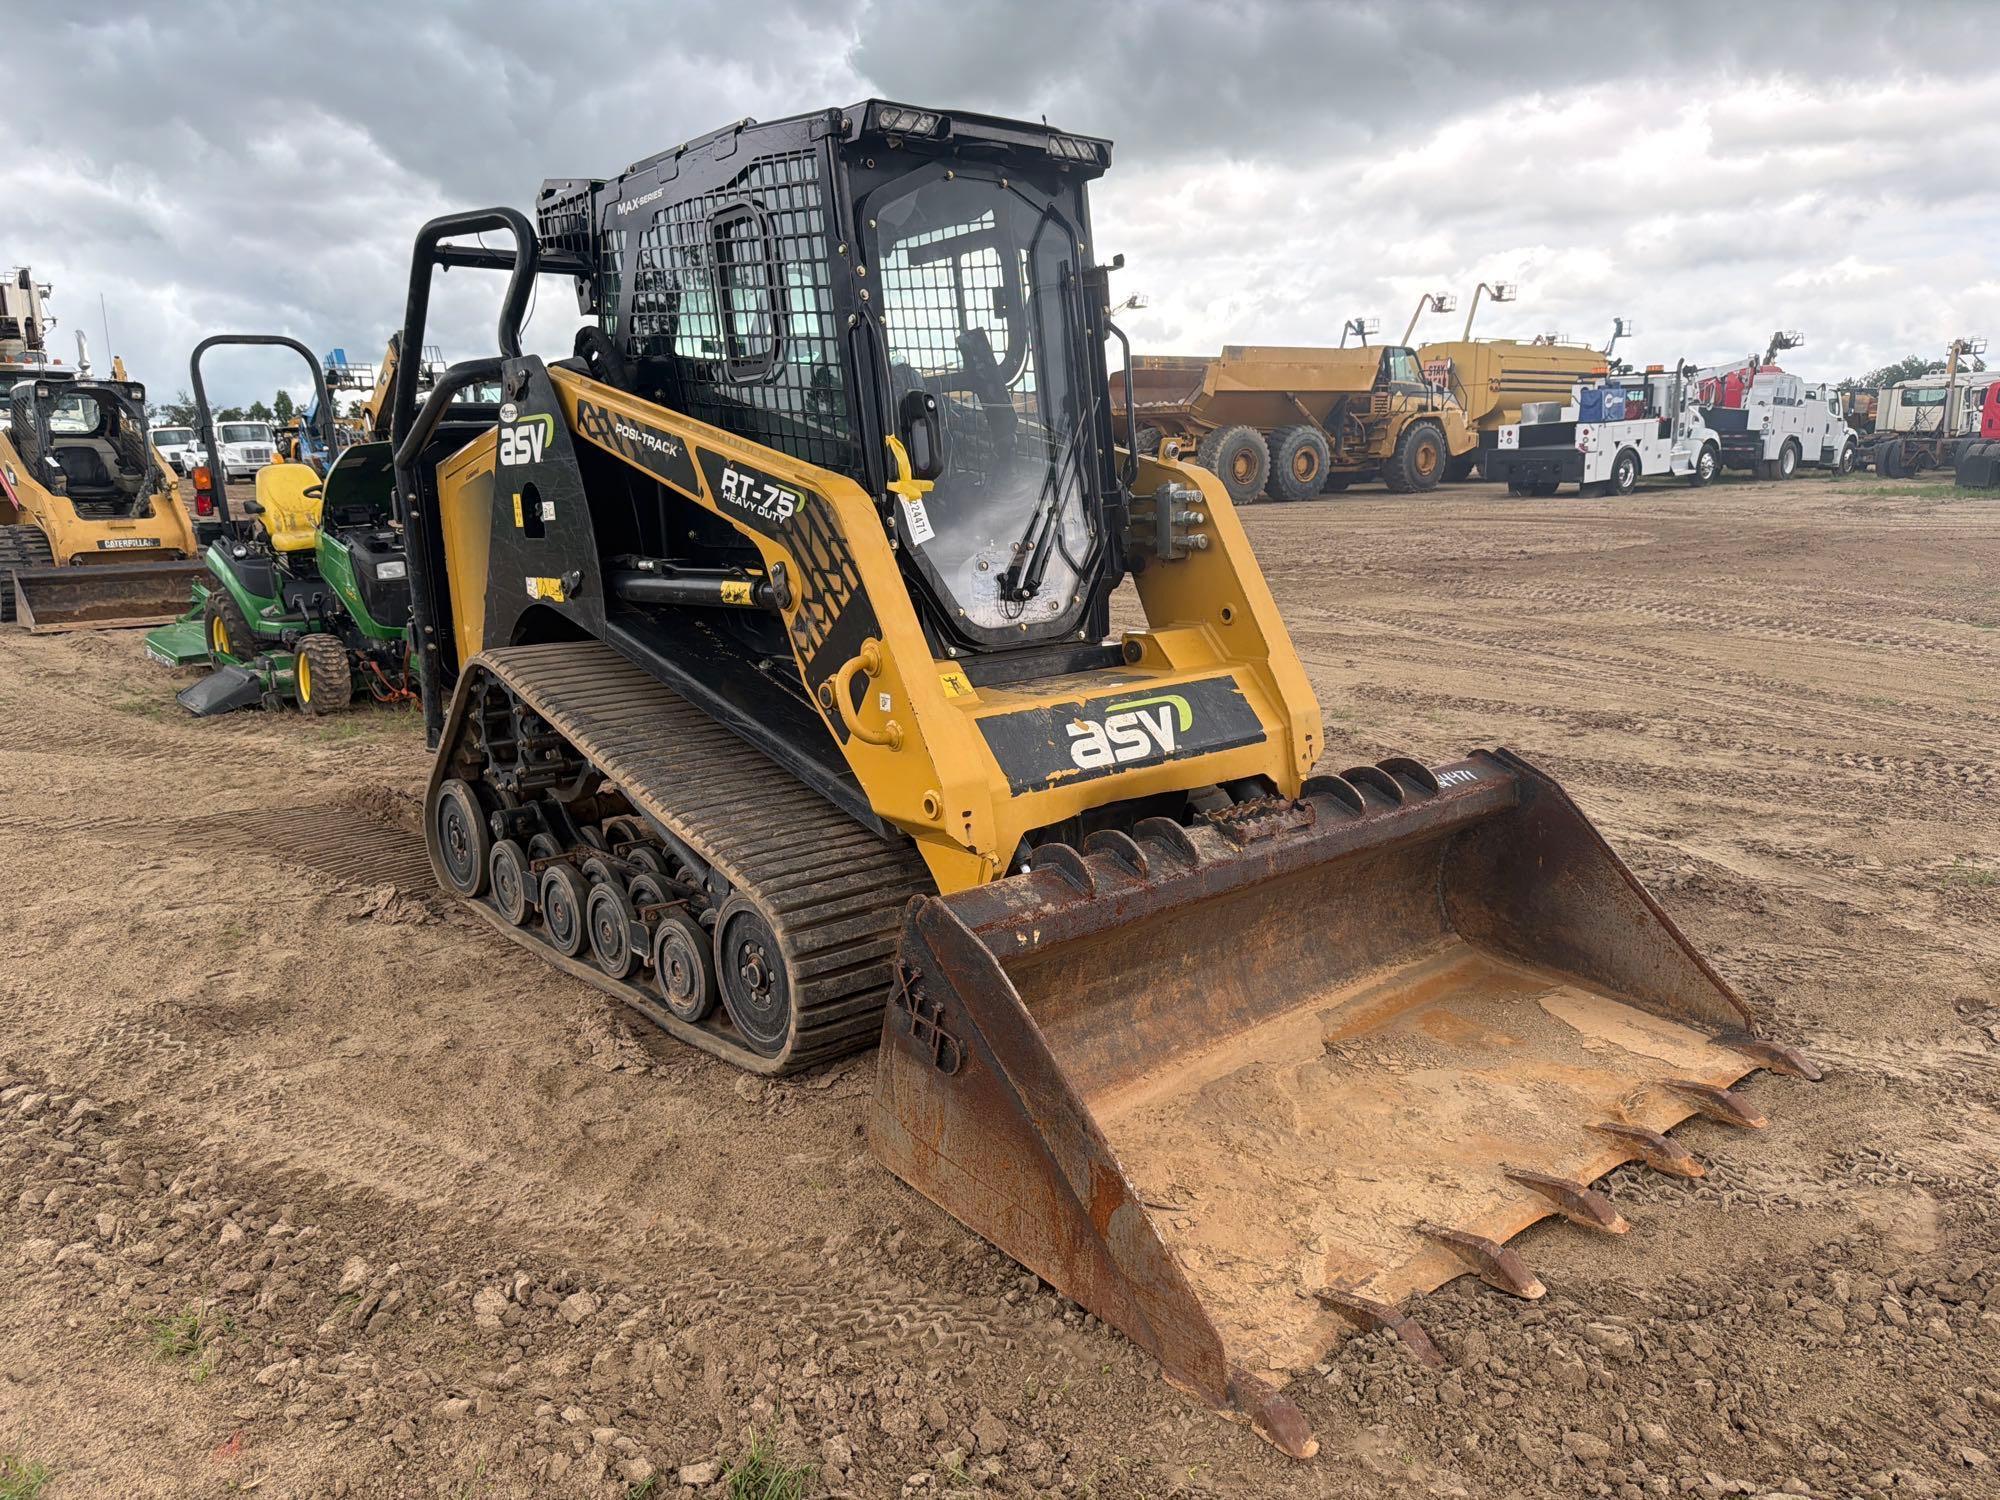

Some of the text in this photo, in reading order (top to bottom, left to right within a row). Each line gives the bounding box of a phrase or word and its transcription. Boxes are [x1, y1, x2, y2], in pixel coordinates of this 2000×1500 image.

[617, 190, 663, 215] MAX-SERIES
[1428, 365, 1445, 376] STAY
[615, 423, 677, 457] POSI-TRACK
[721, 468, 796, 517] RT-75
[723, 490, 786, 524] HEAVY DUTY
[104, 538, 156, 549] CATERPILLAR
